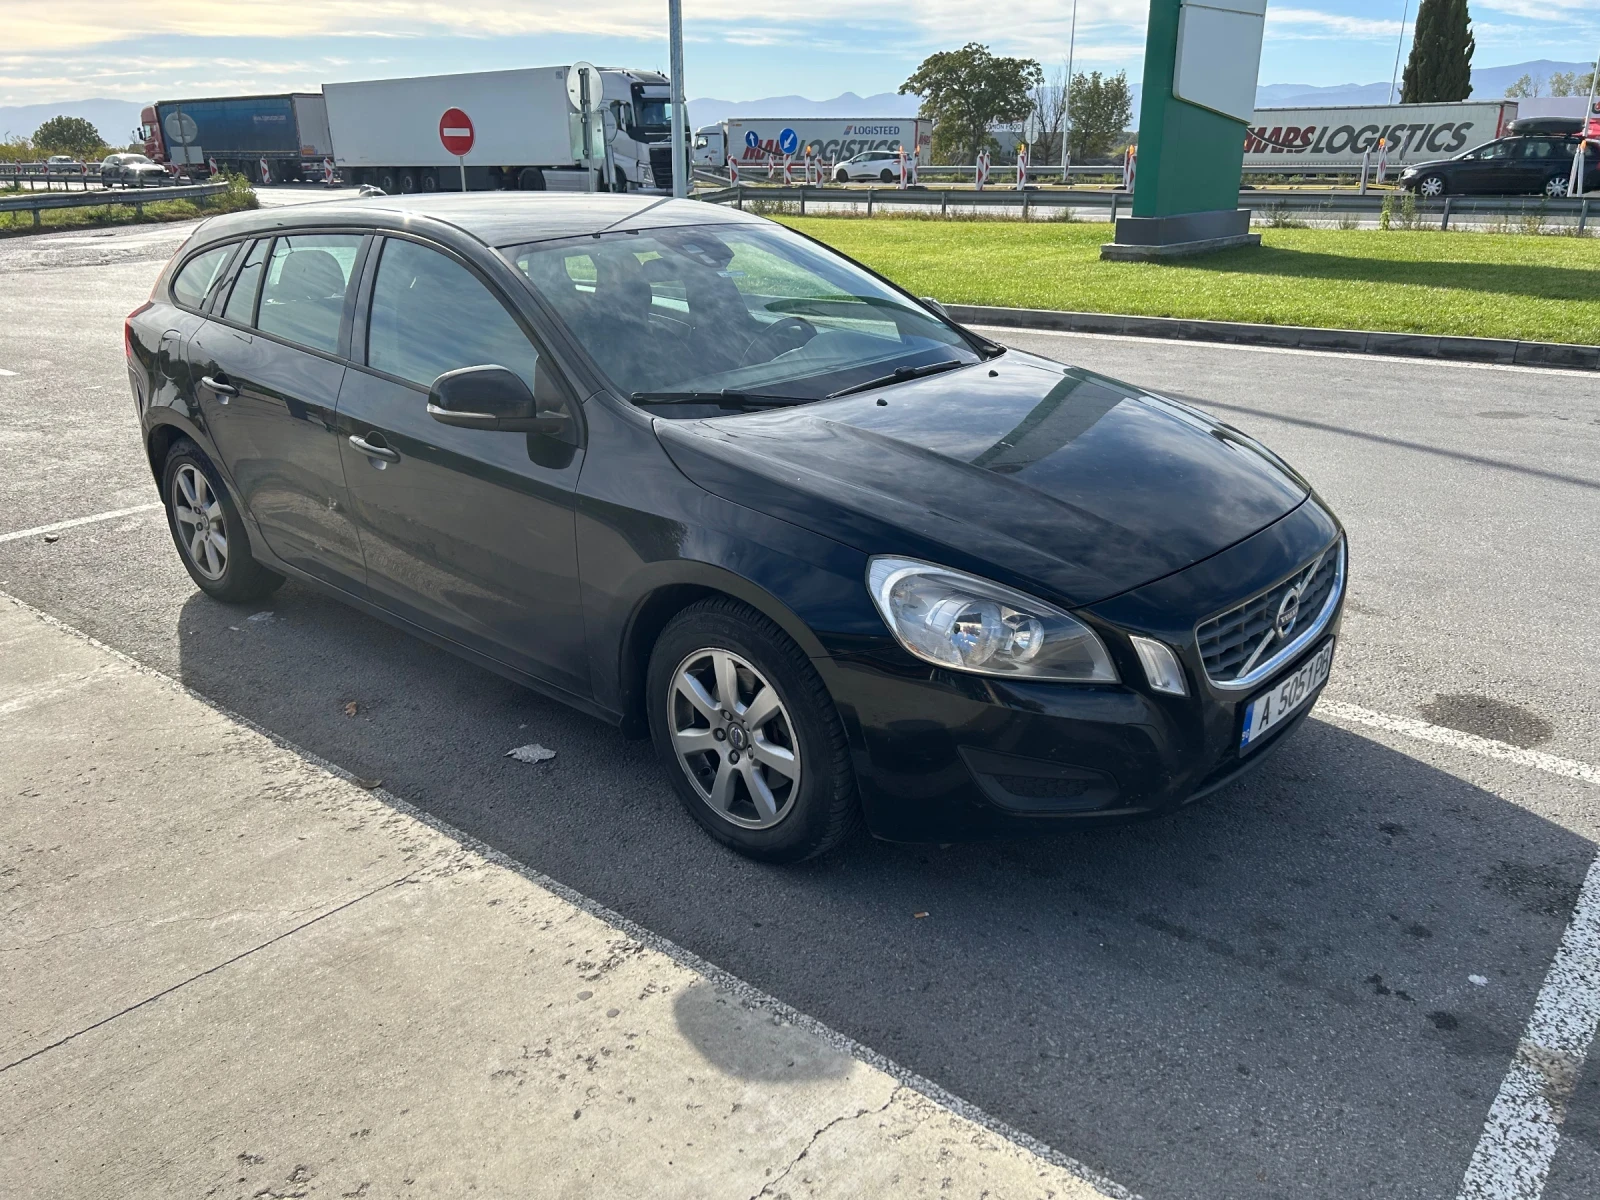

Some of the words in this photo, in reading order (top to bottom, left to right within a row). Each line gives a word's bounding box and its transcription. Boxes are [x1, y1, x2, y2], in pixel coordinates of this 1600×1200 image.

[854, 125, 900, 135] LOGISTEED
[1243, 125, 1317, 154] MARS
[1310, 121, 1475, 155] LOGISTICS
[1258, 695, 1271, 731] A
